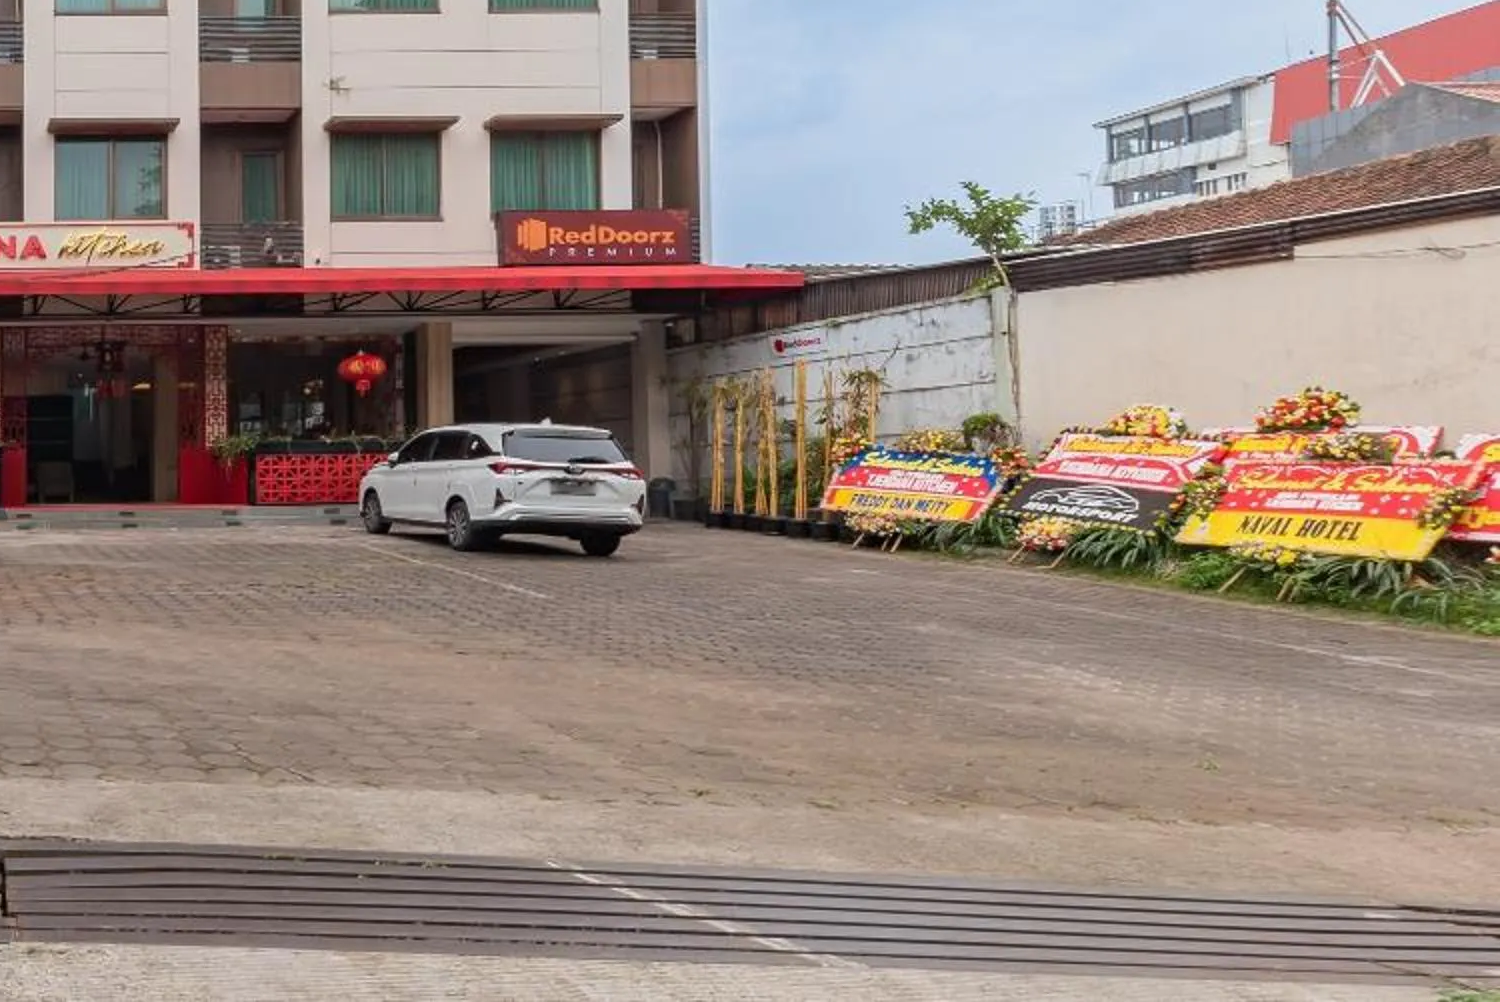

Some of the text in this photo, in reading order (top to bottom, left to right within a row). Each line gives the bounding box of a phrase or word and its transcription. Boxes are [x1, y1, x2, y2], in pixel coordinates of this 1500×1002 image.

[549, 224, 675, 245] RedDoorz
[549, 247, 676, 258] PREMIUM
[1236, 514, 1364, 541] NAVAL HOTEL
